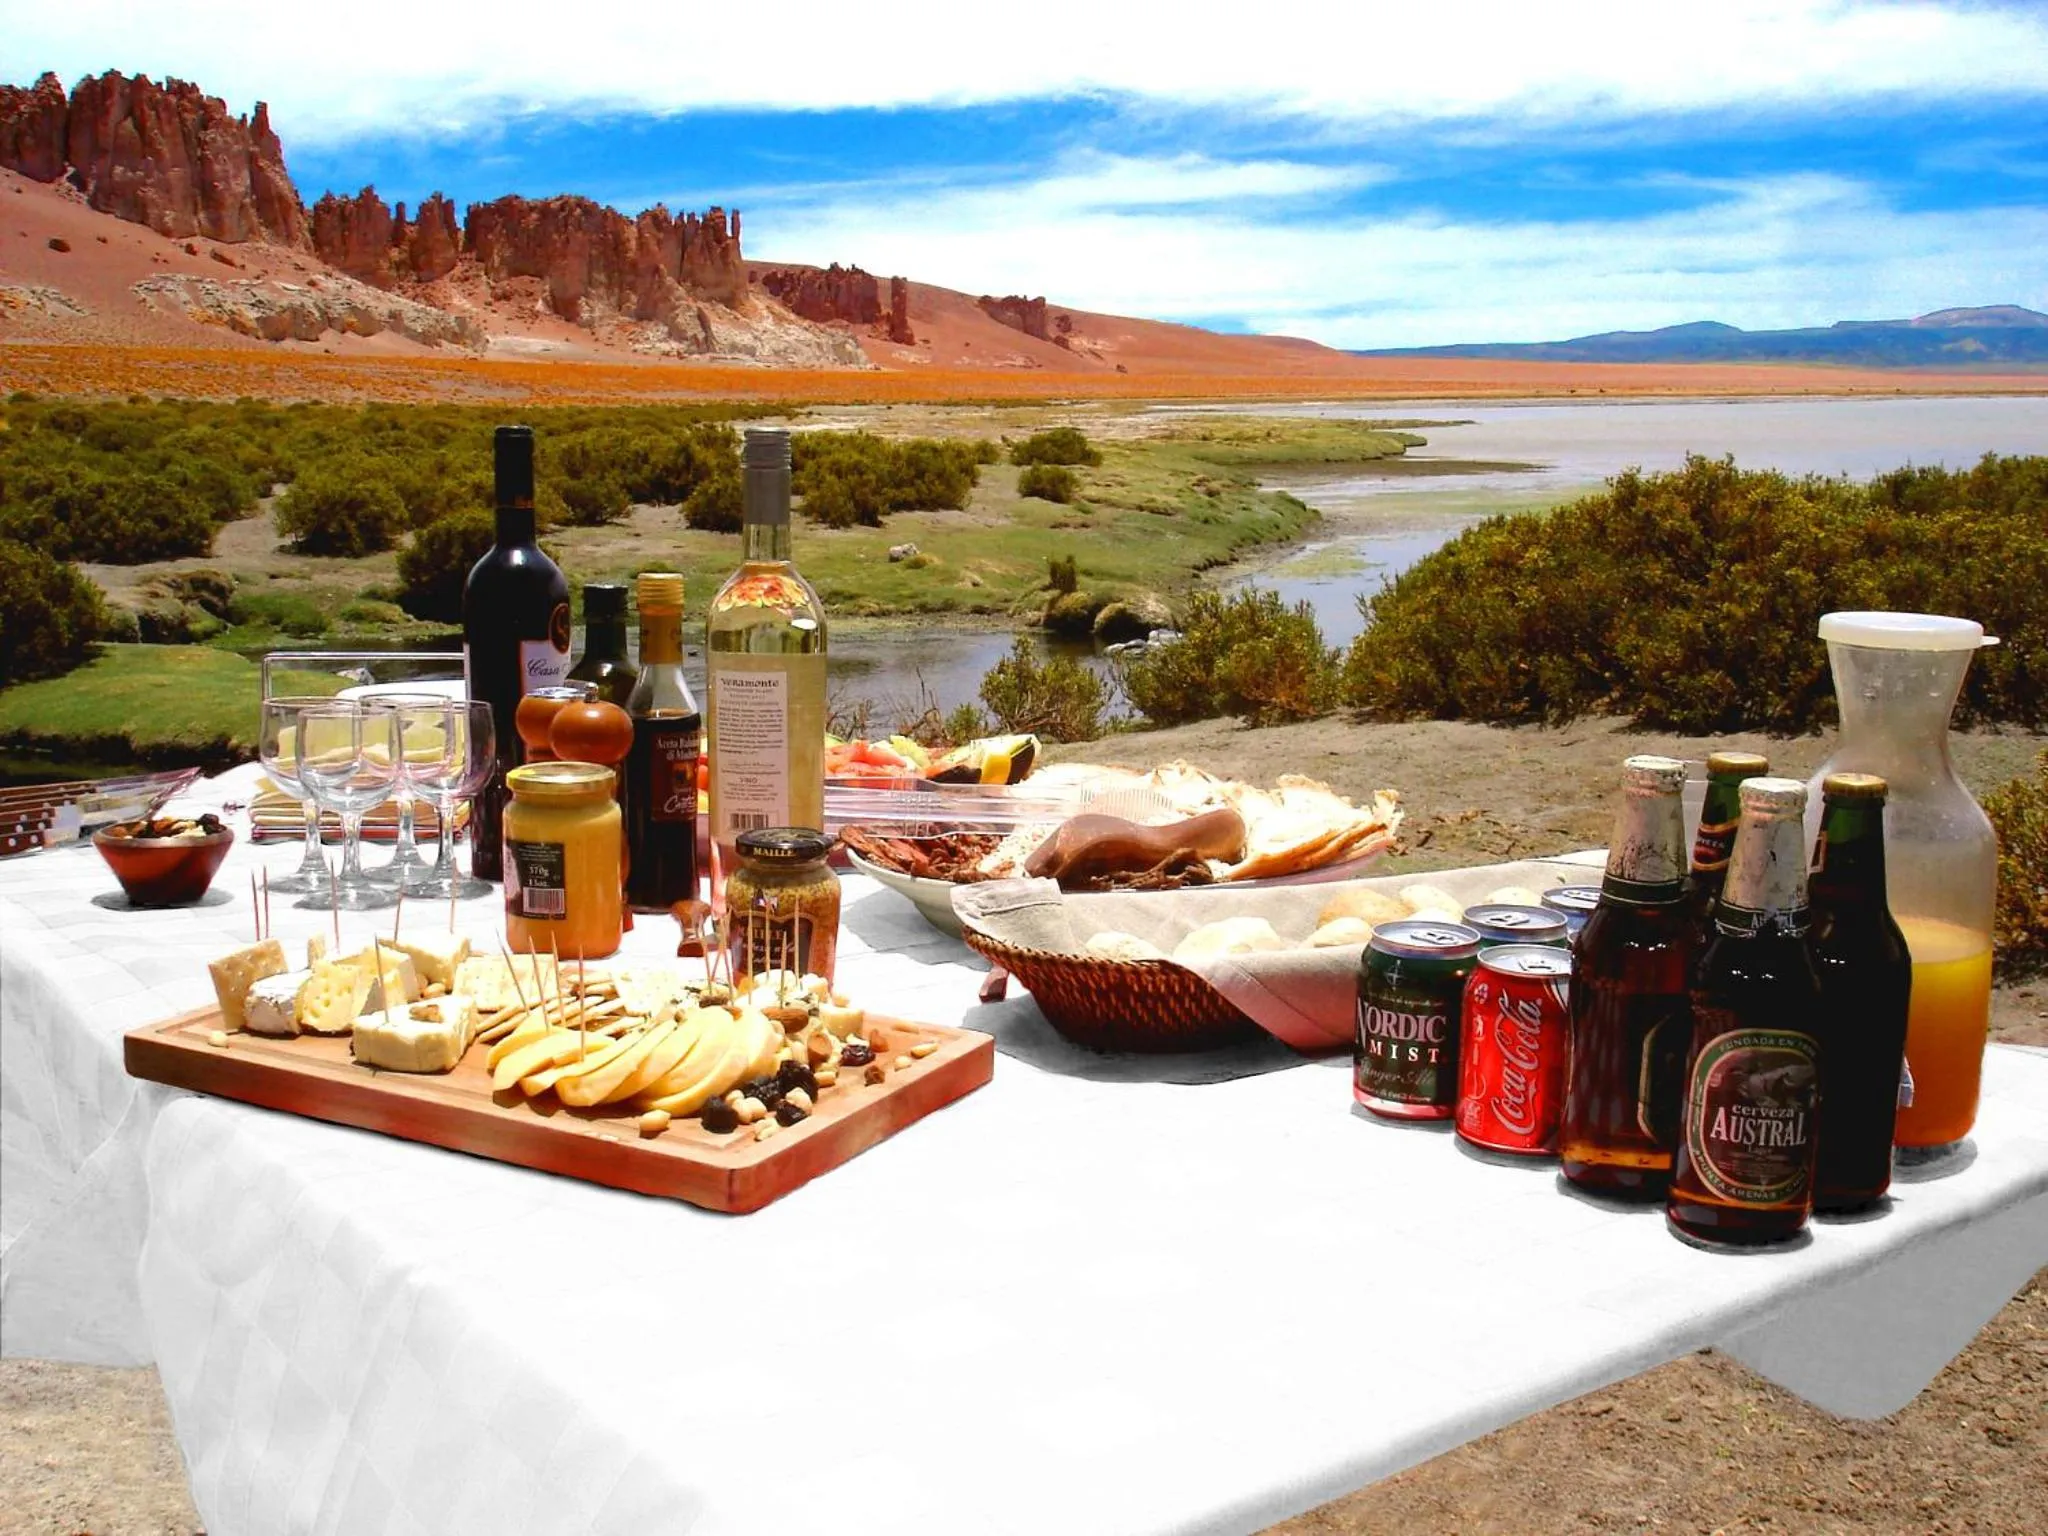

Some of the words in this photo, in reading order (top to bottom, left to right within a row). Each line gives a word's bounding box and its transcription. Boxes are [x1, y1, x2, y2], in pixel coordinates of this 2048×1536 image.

[753, 847, 796, 857] MAILLE
[1355, 997, 1447, 1050] NORDIC
[1370, 1040, 1440, 1063] MIST
[1732, 1104, 1796, 1118] cerveza
[1710, 1106, 1808, 1148] AUSTRAL
